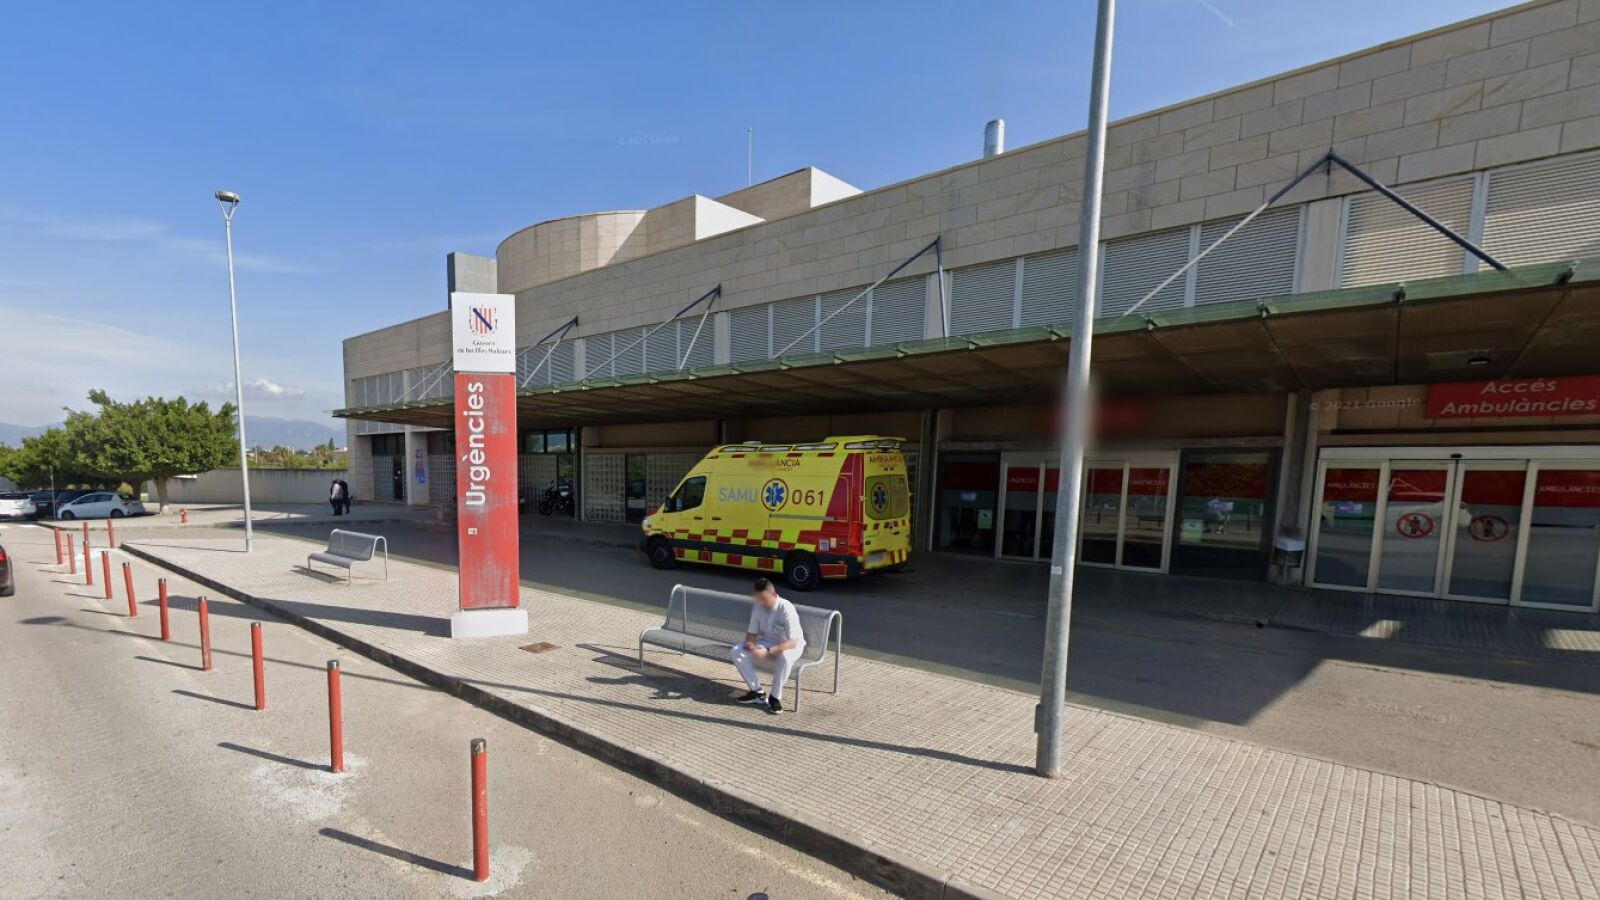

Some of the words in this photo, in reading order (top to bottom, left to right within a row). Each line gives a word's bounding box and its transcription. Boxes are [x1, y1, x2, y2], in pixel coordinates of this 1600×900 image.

[1481, 378, 1557, 394] Accés
[1441, 397, 1598, 415] Ambulàncies
[462, 382, 490, 505] Urgències
[719, 487, 758, 503] SAMU
[792, 489, 823, 506] 061
